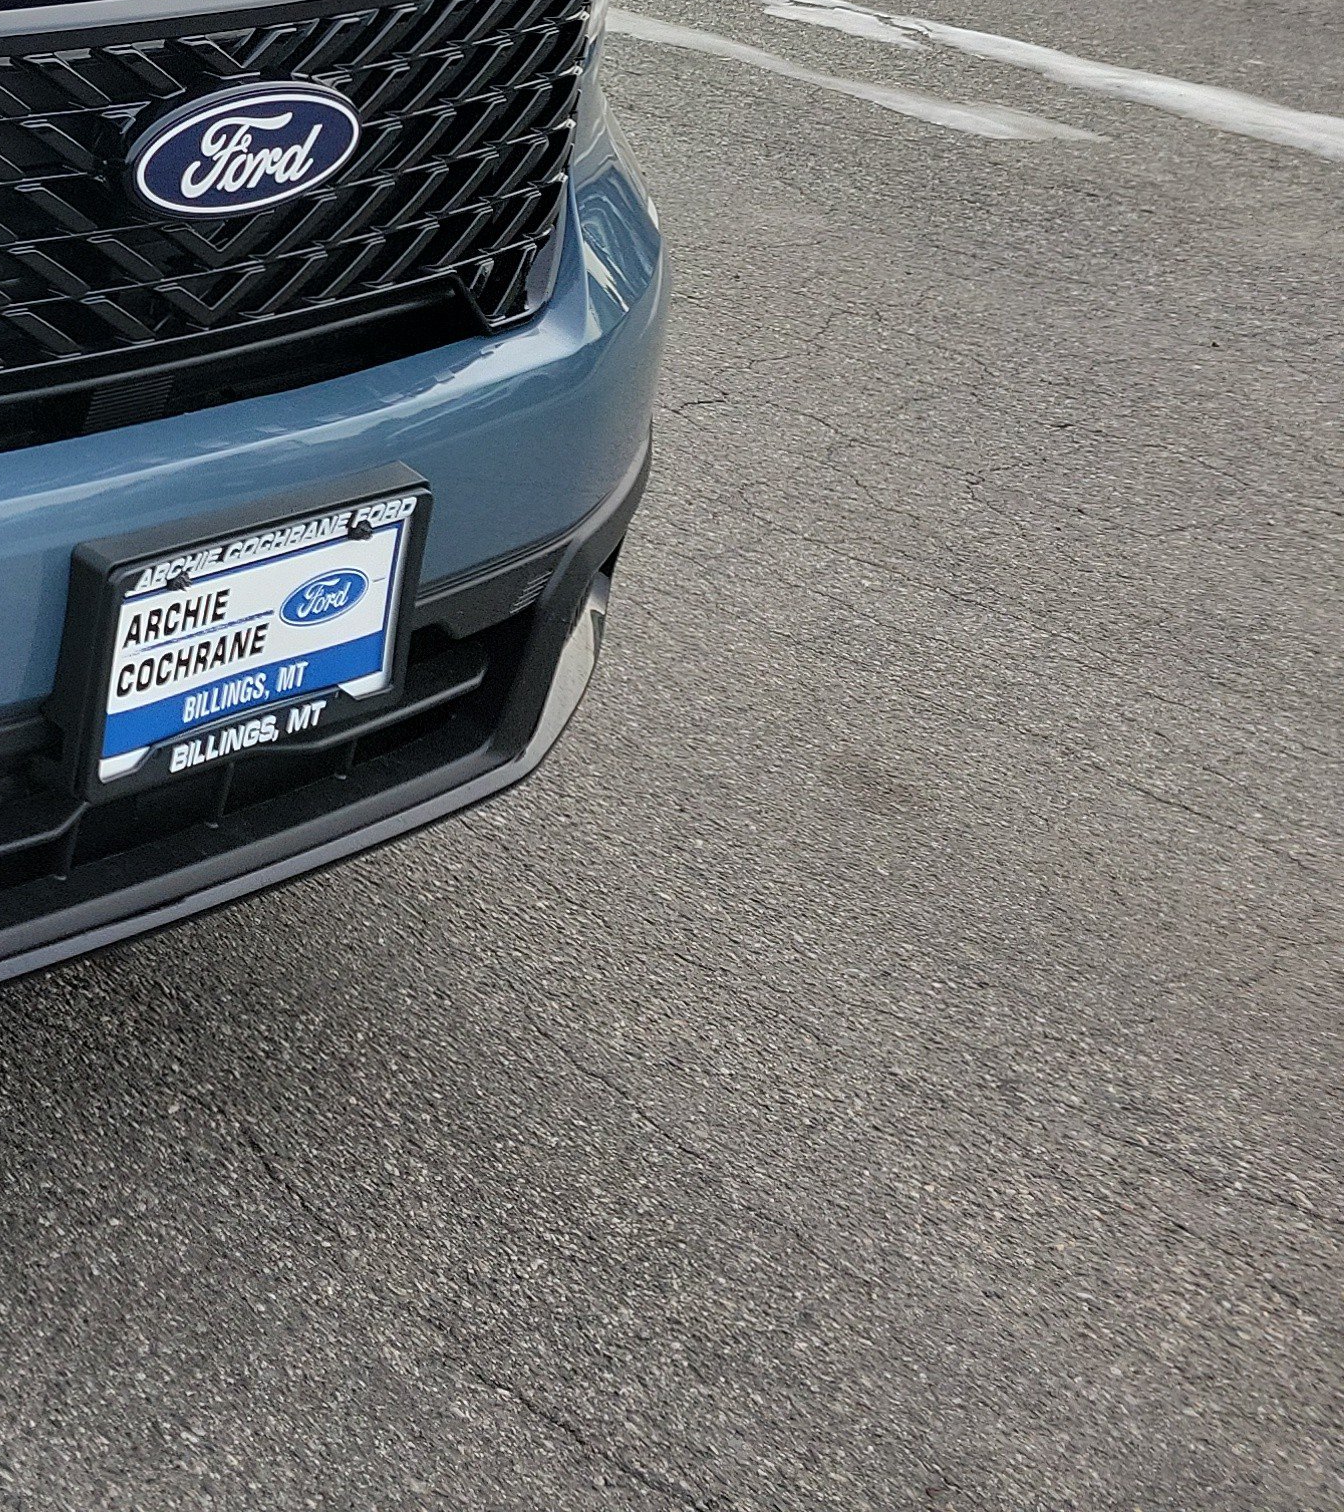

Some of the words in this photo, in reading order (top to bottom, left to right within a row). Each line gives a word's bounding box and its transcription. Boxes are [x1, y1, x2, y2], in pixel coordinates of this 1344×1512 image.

[180, 111, 323, 199] Ford
[124, 547, 223, 598] ARCHIE
[223, 511, 352, 564] COCHRANE
[352, 496, 418, 530] FORD
[123, 588, 231, 649] ARCHIE
[297, 577, 352, 619] Ford
[116, 622, 270, 698] COCHRANE
[182, 672, 270, 724] BILLINGS,
[276, 660, 309, 693] MT
[169, 714, 280, 774] BILLINGS,
[285, 699, 327, 735] MT
